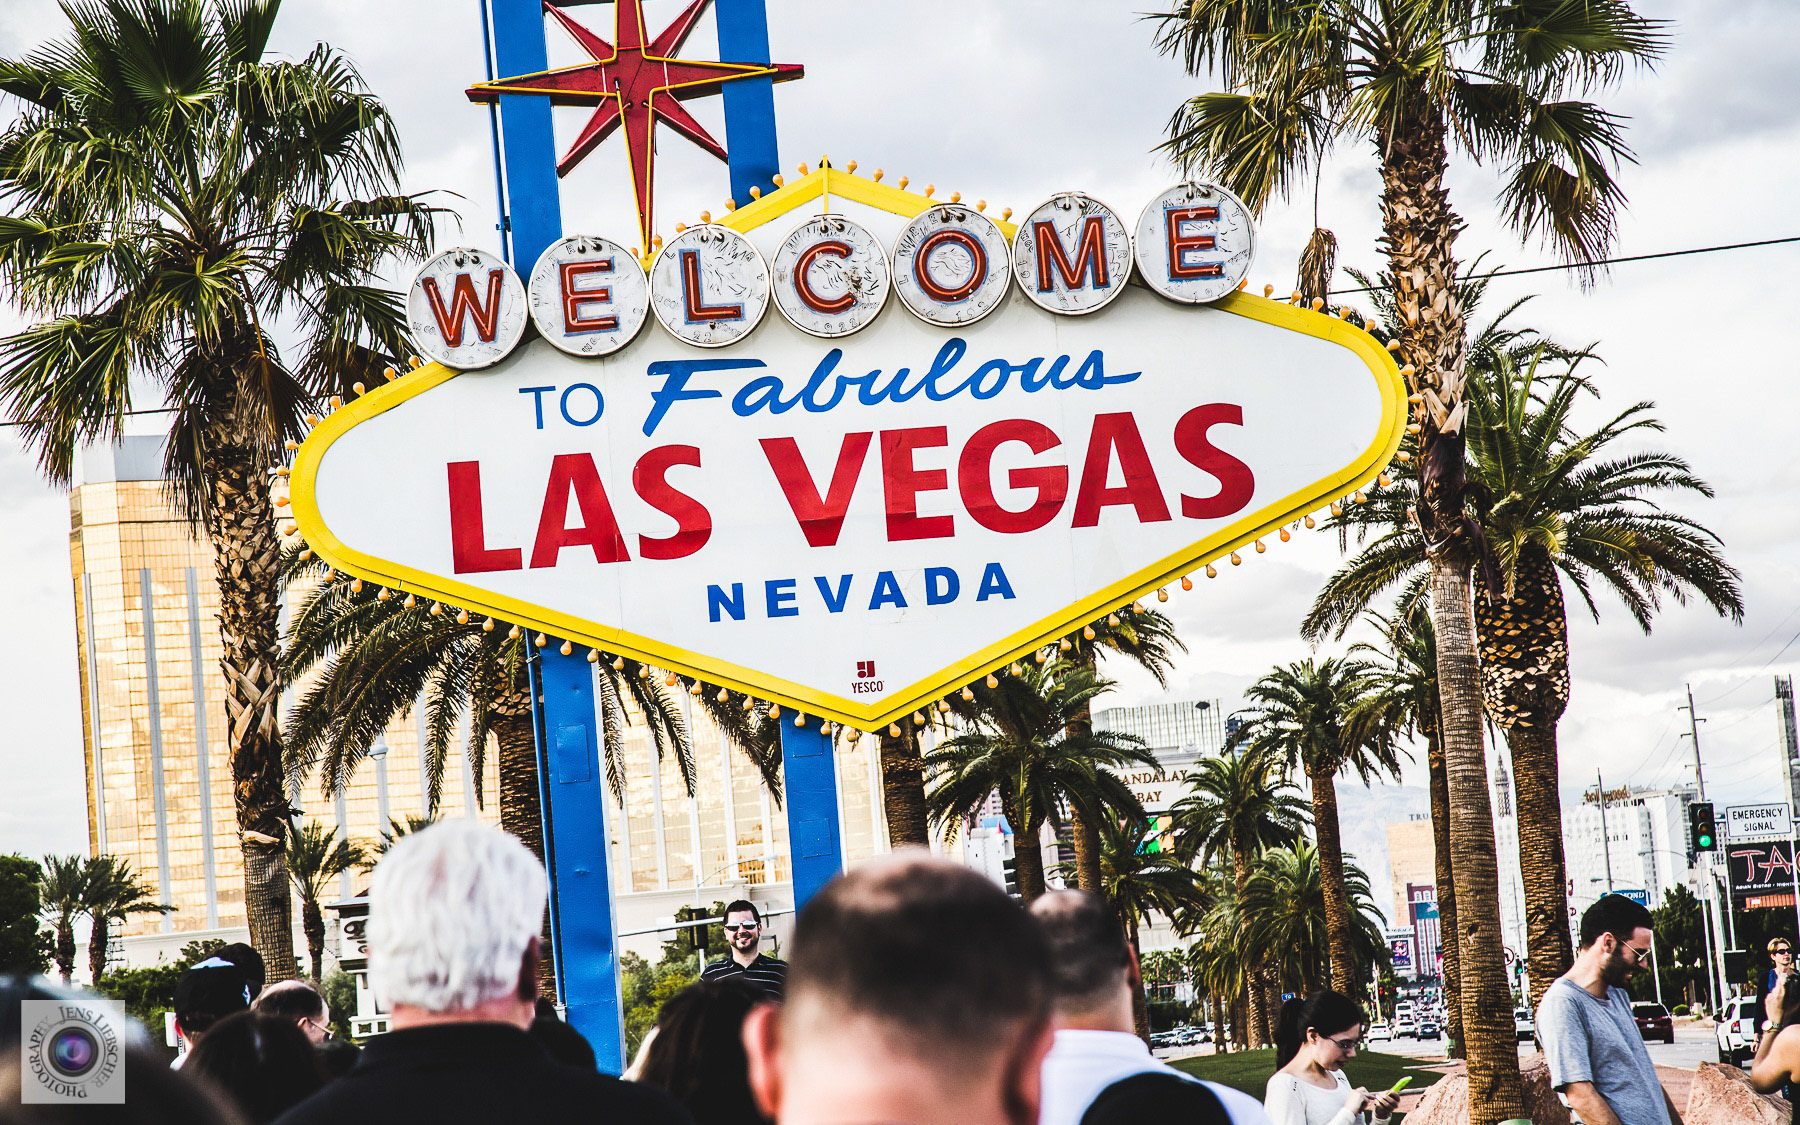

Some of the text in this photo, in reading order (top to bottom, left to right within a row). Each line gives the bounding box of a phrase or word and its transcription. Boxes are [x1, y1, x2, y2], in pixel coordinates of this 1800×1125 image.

[419, 204, 1225, 349] WELCOME
[519, 337, 1143, 437] TO Fabulous
[446, 402, 1256, 574] LAS VEGAS
[707, 562, 1017, 623] NEVADA
[851, 680, 884, 694] YESCO
[1122, 769, 1188, 785] ANDALAY
[1136, 790, 1162, 803] BAY
[1408, 812, 1429, 822] TRU
[1732, 807, 1783, 820] EMERGENCY
[1744, 821, 1775, 832] SIGNAL
